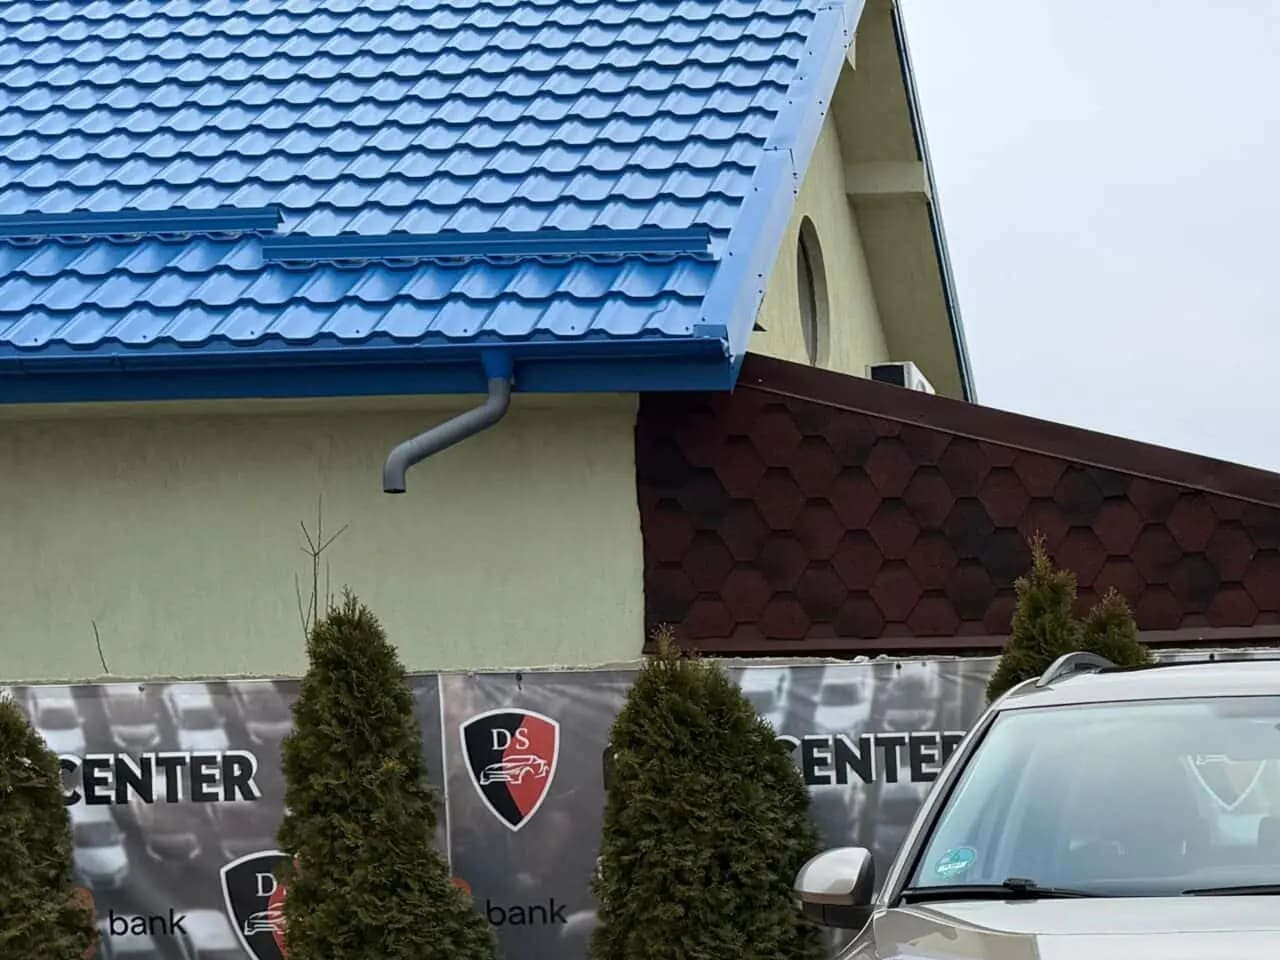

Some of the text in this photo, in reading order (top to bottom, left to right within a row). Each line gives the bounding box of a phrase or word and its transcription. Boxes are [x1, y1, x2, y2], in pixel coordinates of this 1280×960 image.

[491, 728, 529, 750] DS
[60, 751, 261, 806] CENTER
[109, 909, 187, 936] bank
[486, 897, 568, 926] bank
